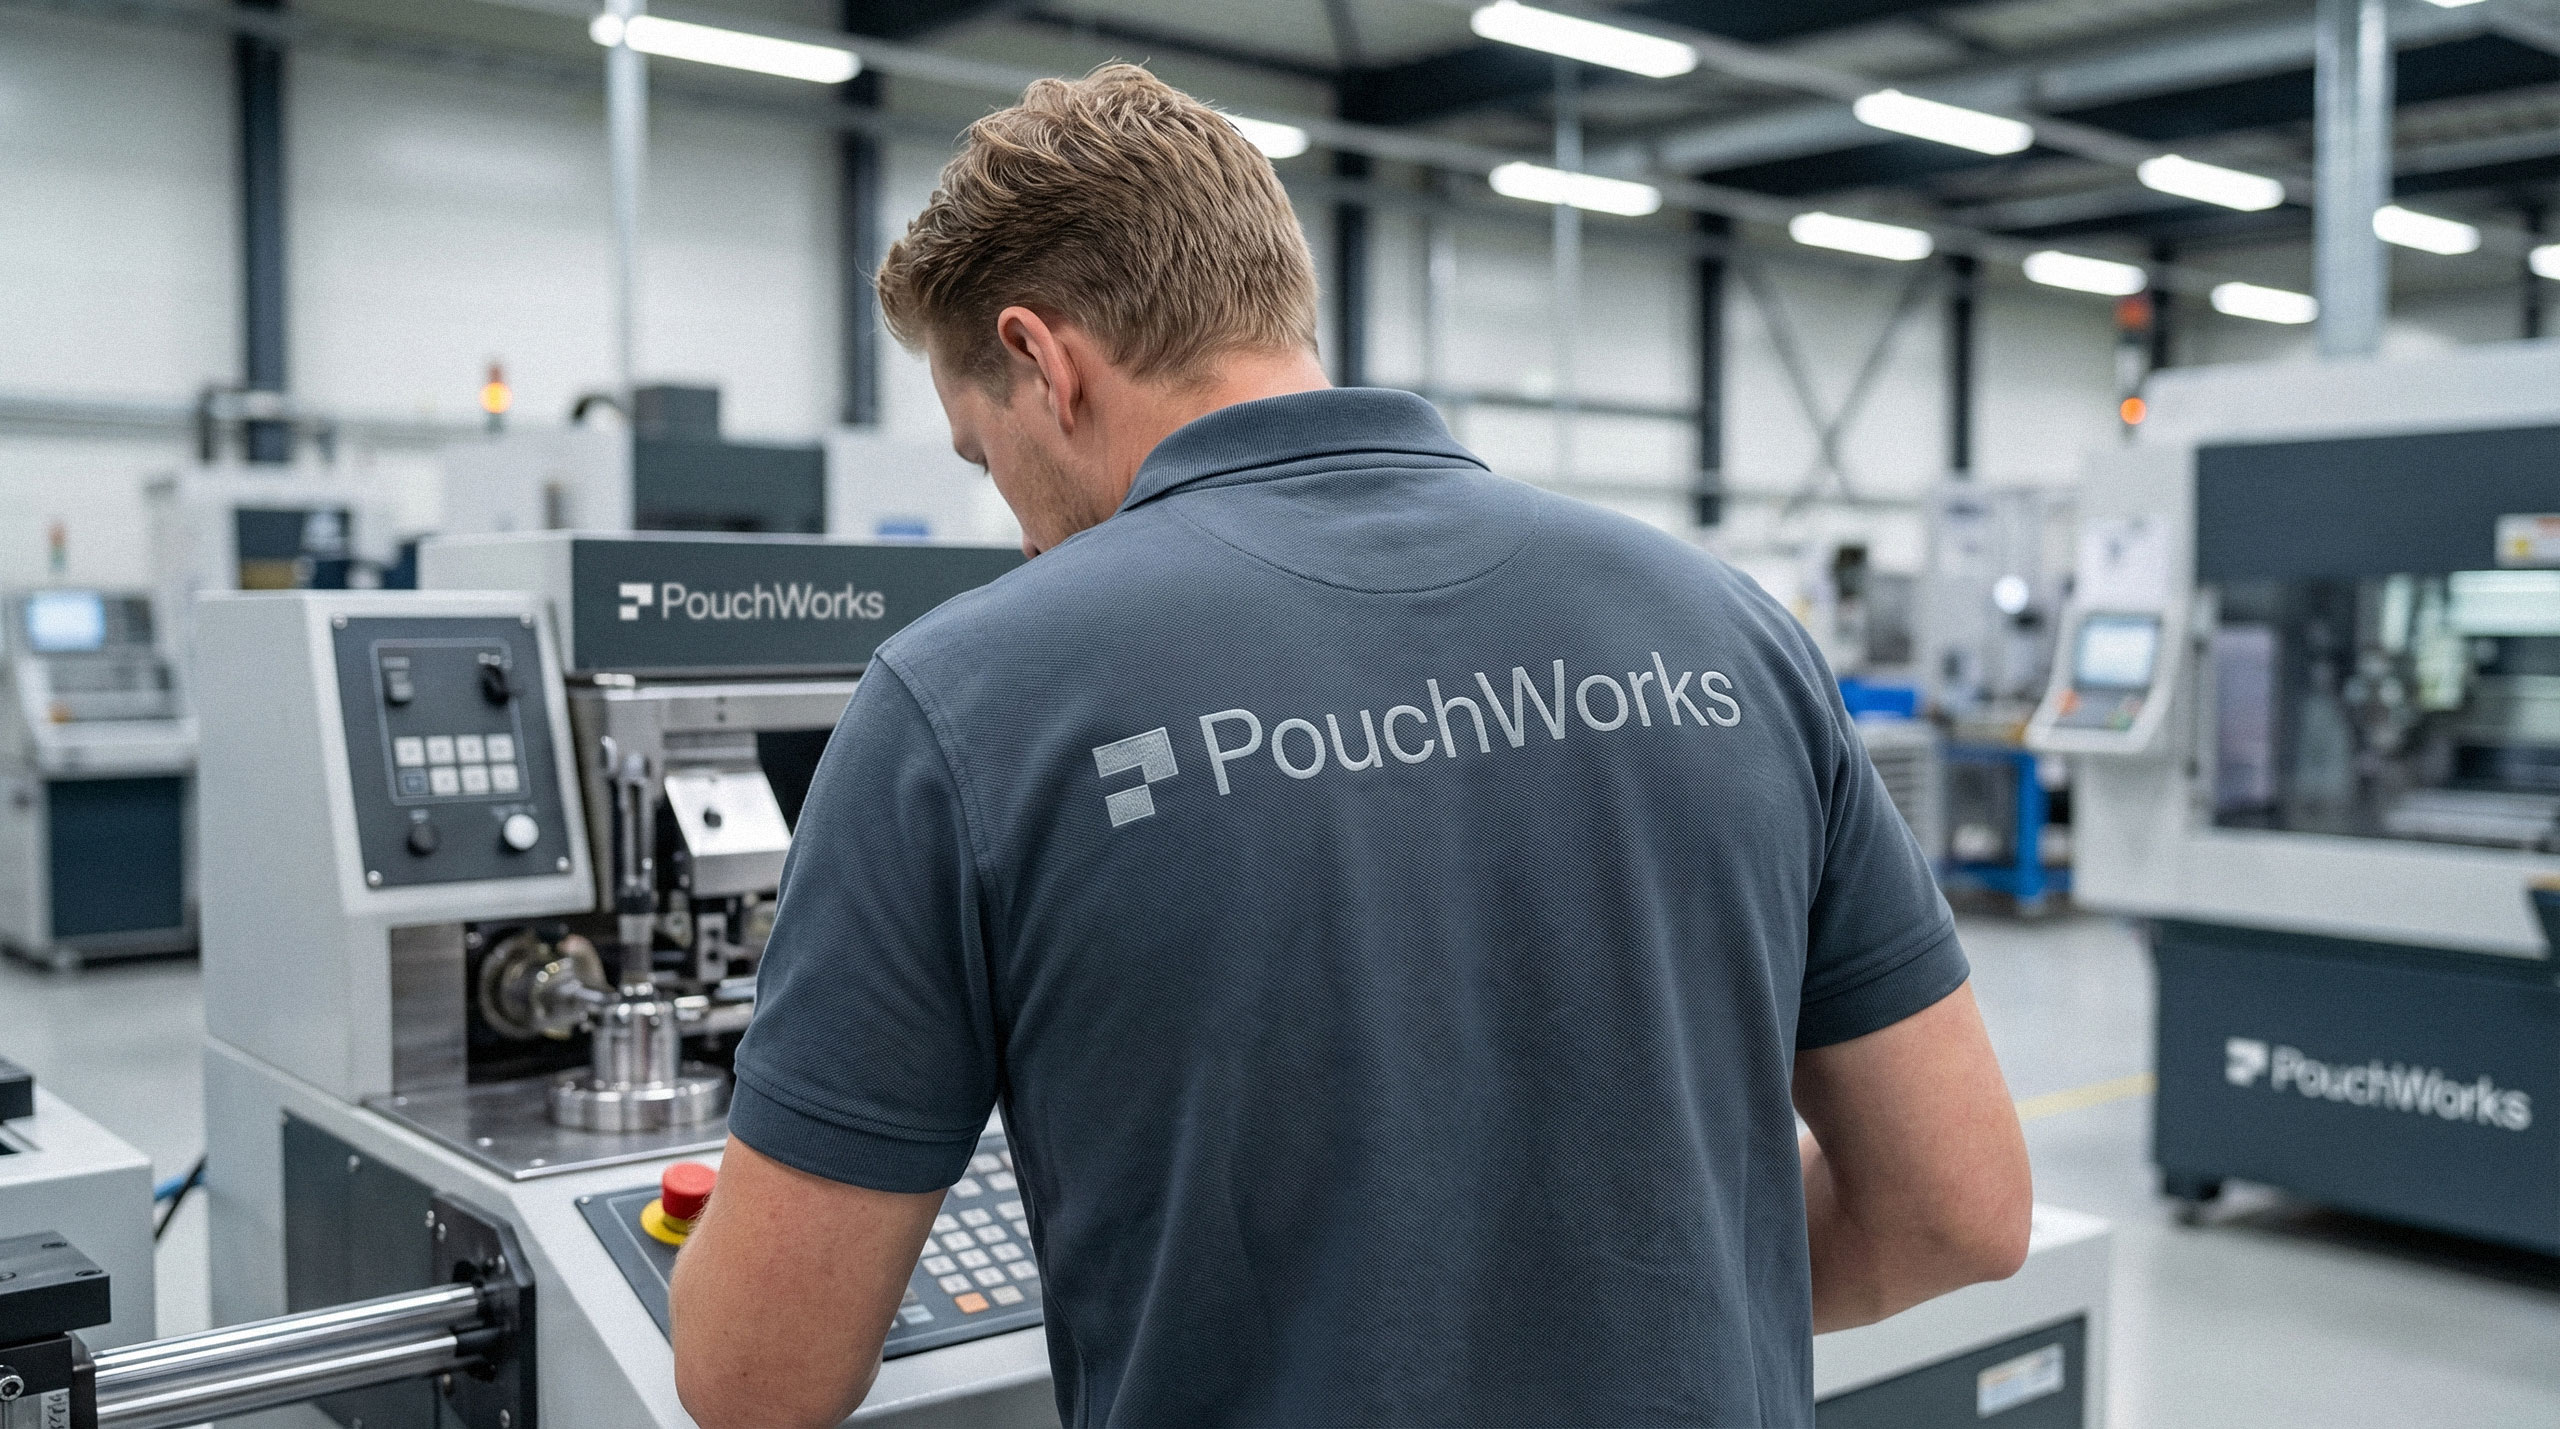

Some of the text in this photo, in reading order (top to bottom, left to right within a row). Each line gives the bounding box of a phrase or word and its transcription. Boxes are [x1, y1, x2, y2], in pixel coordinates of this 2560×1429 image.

[661, 582, 885, 620] PouchWorks
[1199, 652, 1741, 795] PouchWorks
[2271, 1046, 2532, 1131] PouchWorks
